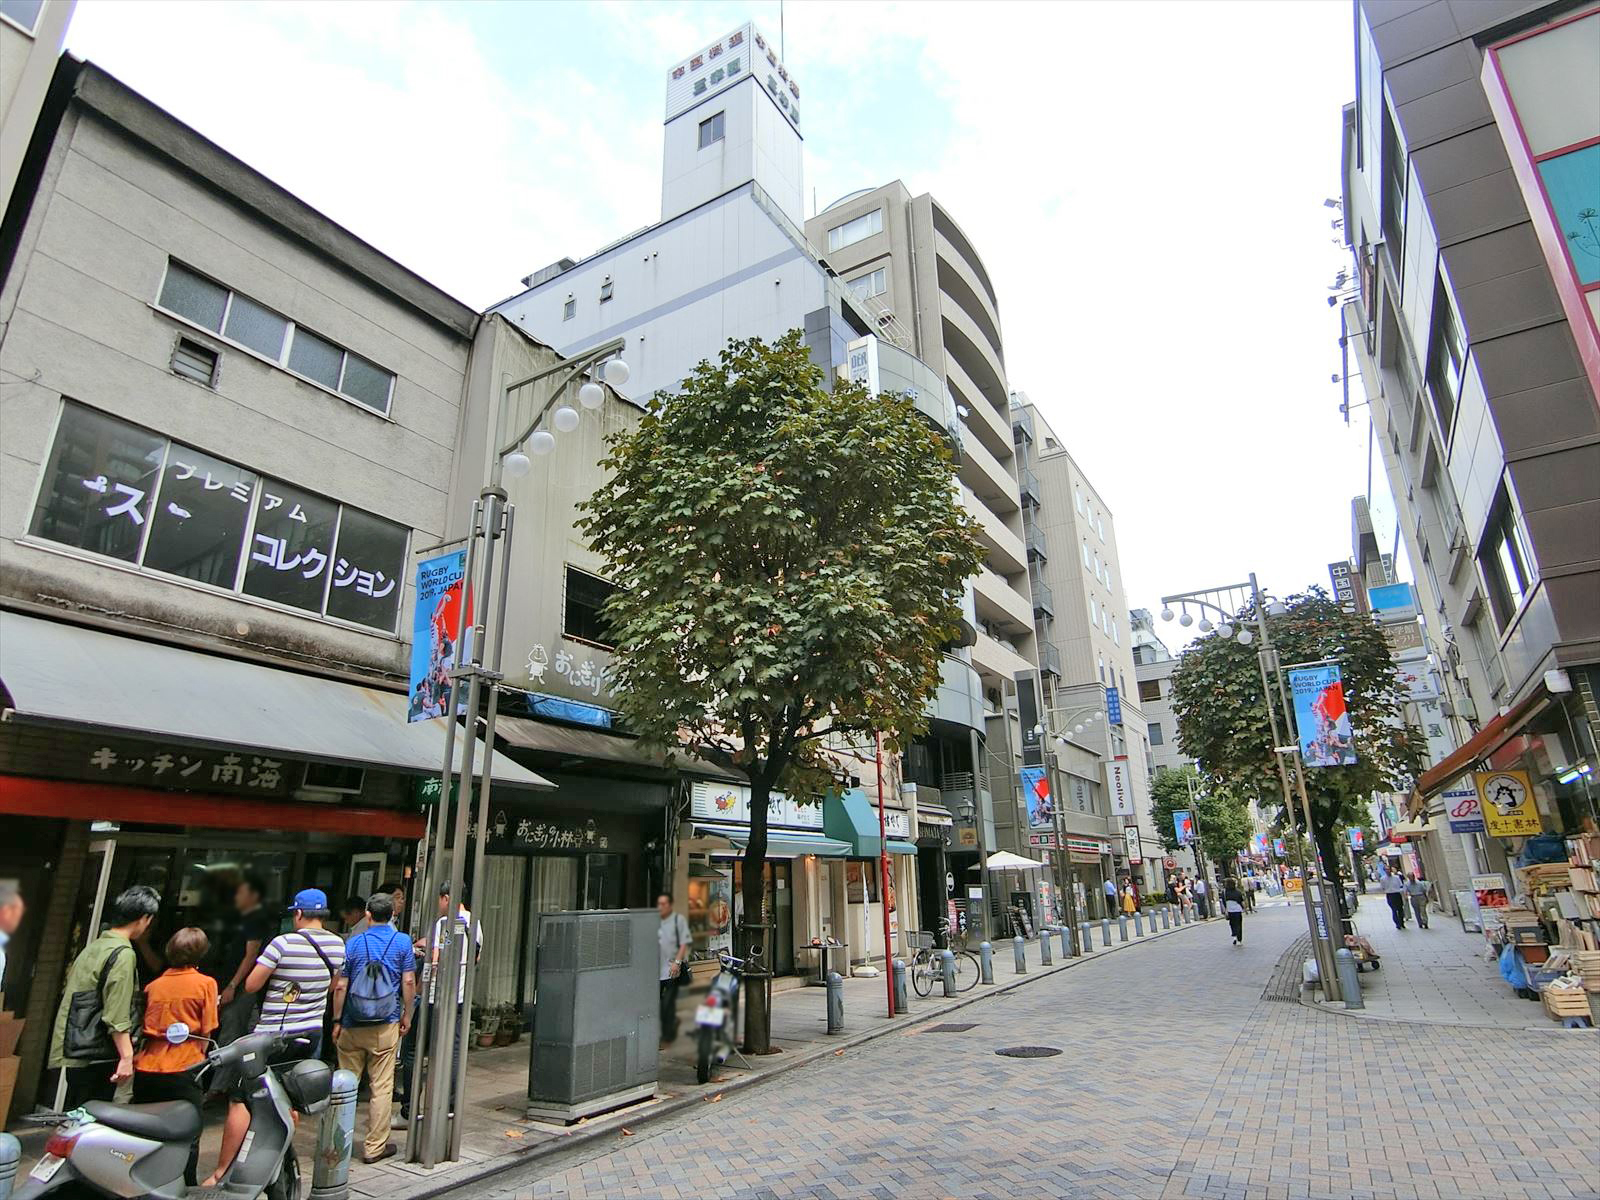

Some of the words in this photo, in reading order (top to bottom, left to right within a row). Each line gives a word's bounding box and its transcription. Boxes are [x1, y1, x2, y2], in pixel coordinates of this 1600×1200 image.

[176, 461, 307, 523] プレミアム
[252, 533, 396, 598] コレクション
[421, 566, 449, 580] RUGBY
[421, 575, 449, 590] WORLD
[1315, 684, 1339, 693] JAPAN
[90, 747, 202, 777] キッチン
[211, 752, 281, 789] 南海
[1114, 766, 1124, 809] Neolive
